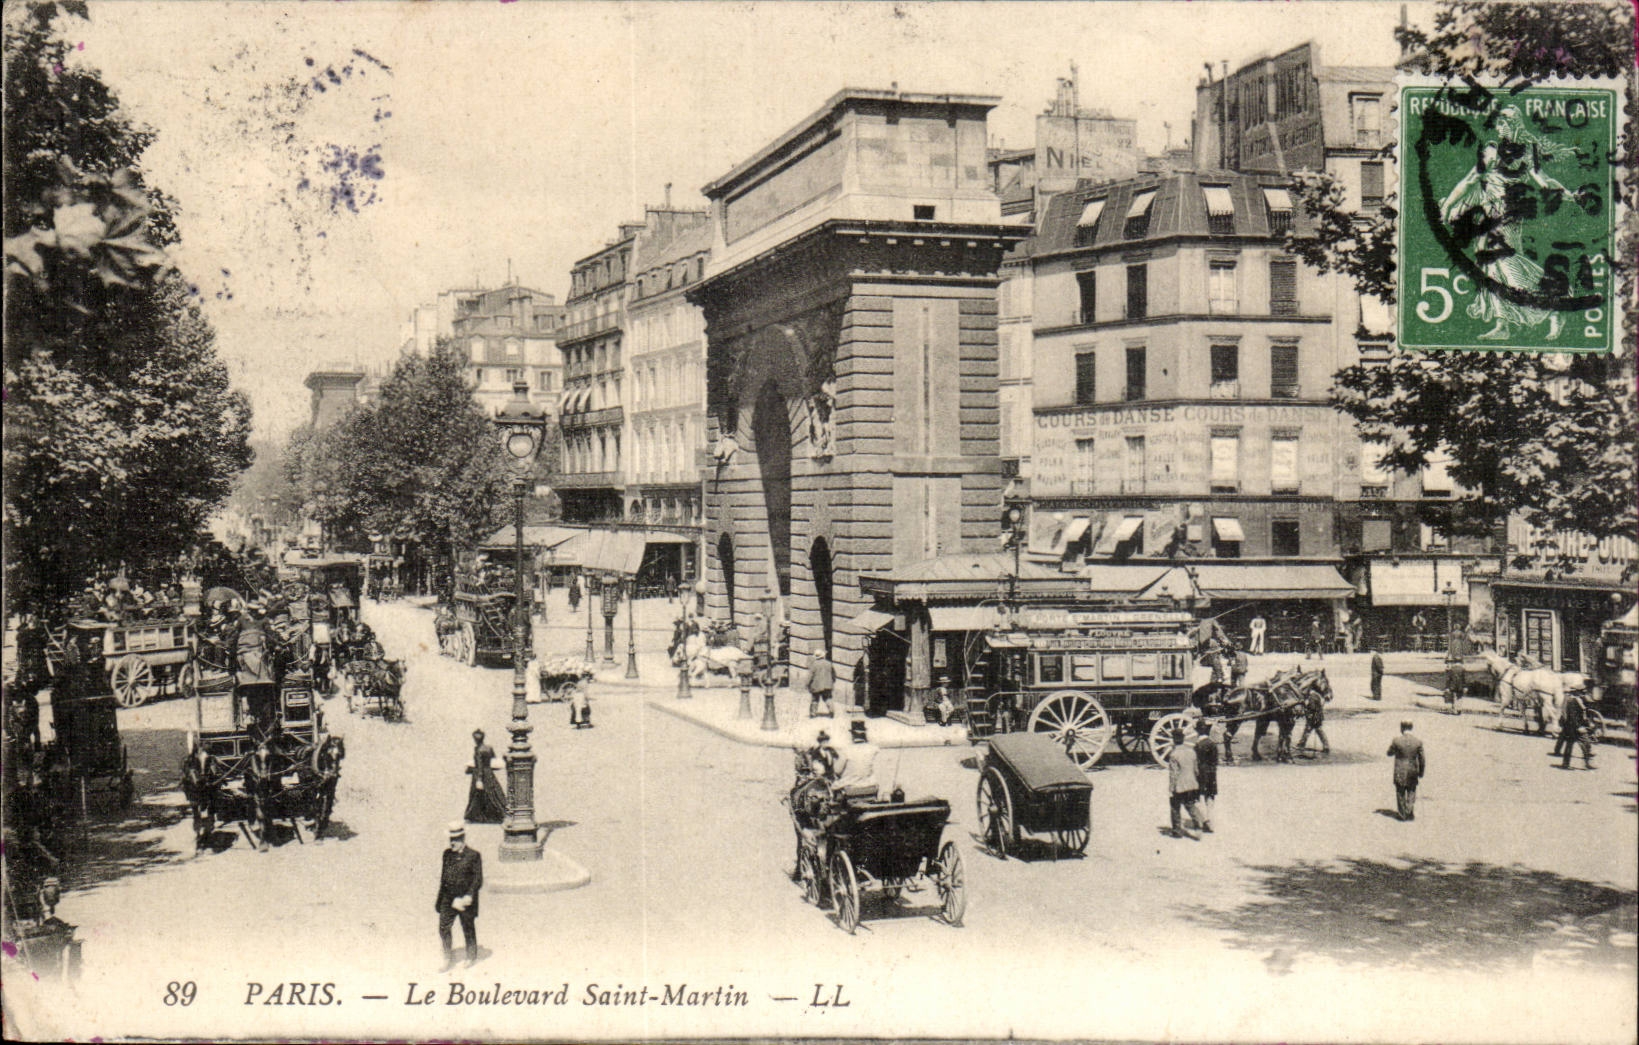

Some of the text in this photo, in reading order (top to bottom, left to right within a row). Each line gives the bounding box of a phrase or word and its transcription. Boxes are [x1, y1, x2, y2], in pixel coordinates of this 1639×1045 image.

[1526, 98, 1607, 119] FRANAISE
[1584, 254, 1606, 338] POTES
[1037, 412, 1097, 428] COURS
[1113, 408, 1175, 425] DANSE
[1184, 407, 1245, 422] COURS
[1267, 408, 1329, 422] DANSE
